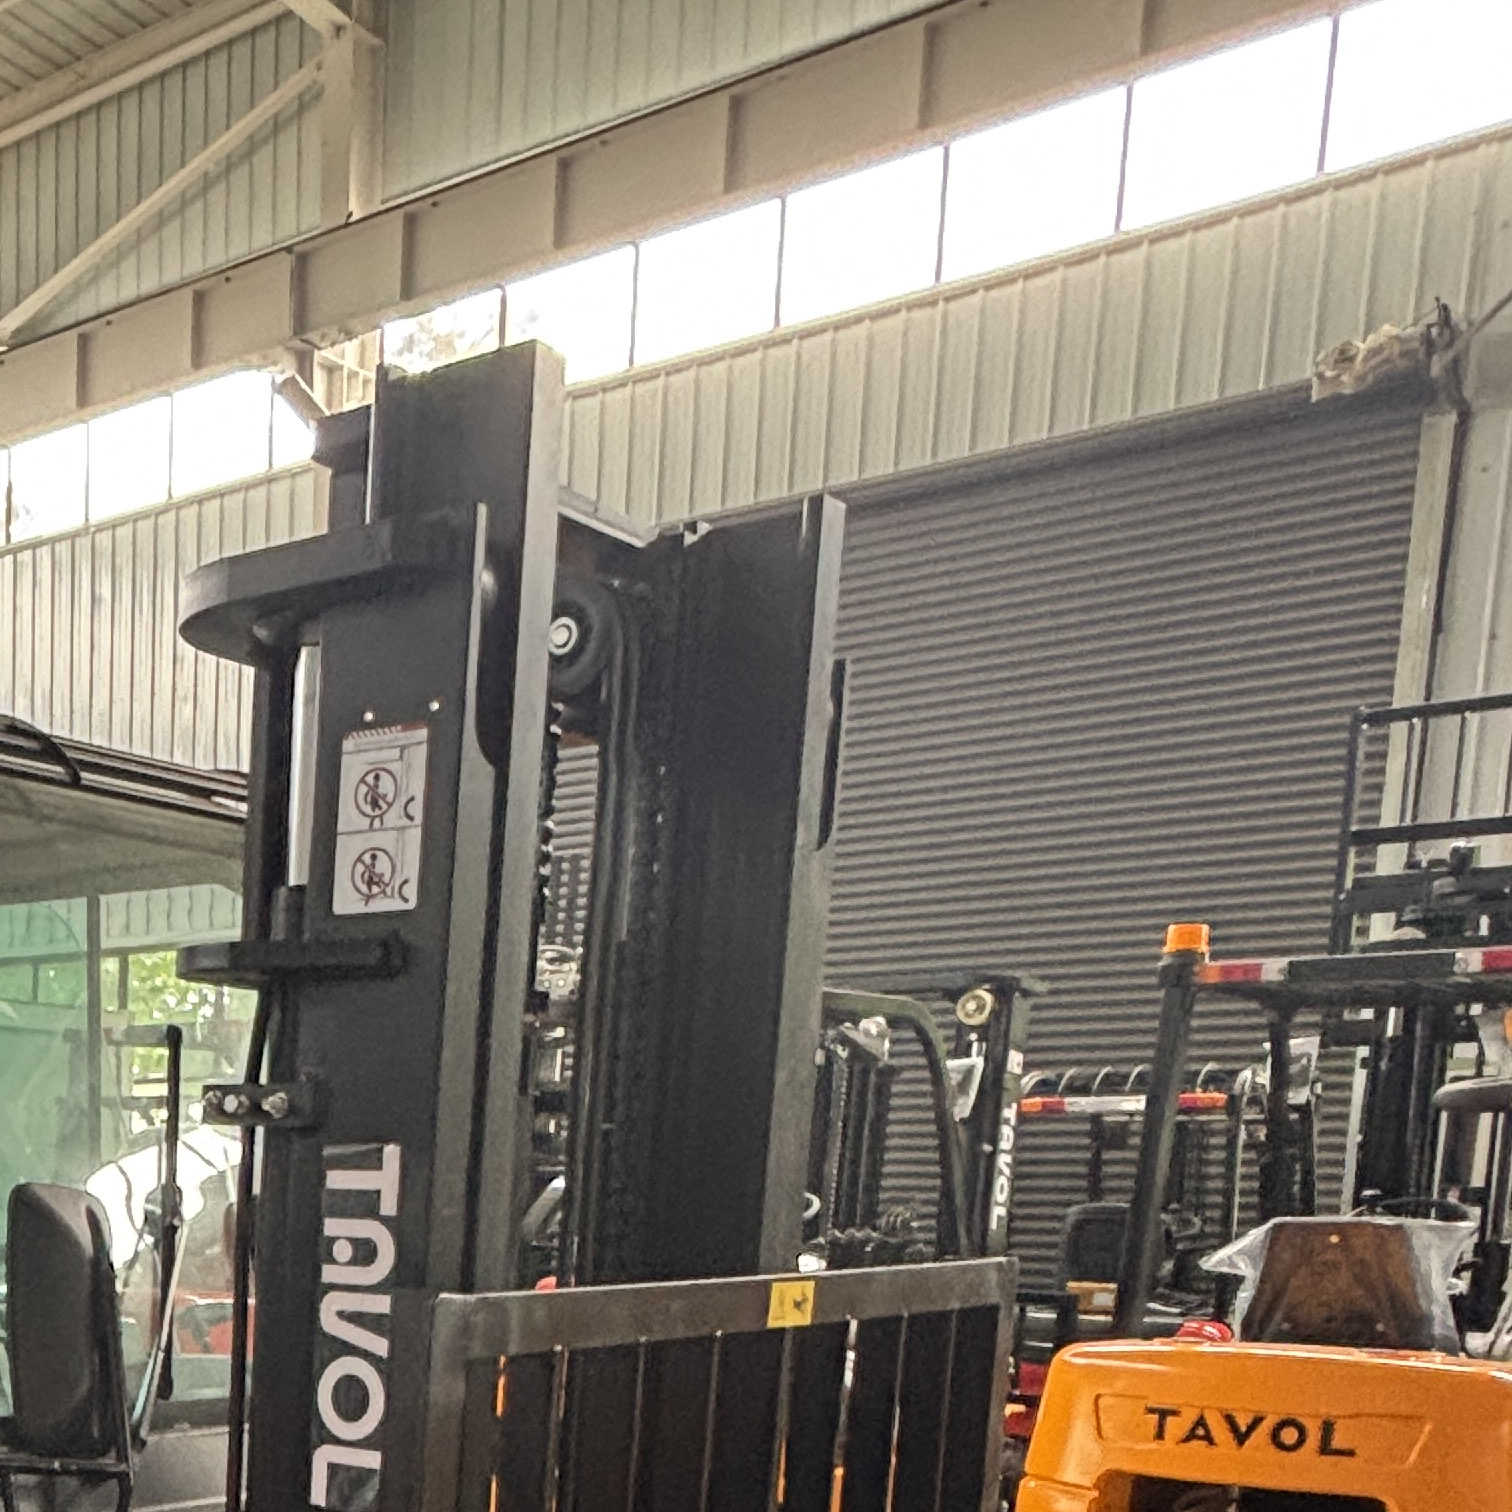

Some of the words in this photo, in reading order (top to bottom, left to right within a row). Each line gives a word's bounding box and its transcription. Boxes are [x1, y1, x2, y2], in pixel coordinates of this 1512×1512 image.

[991, 1103, 1017, 1230] TAVOL
[310, 1143, 400, 1508] TAVOL
[1145, 1406, 1356, 1457] TAVOL
